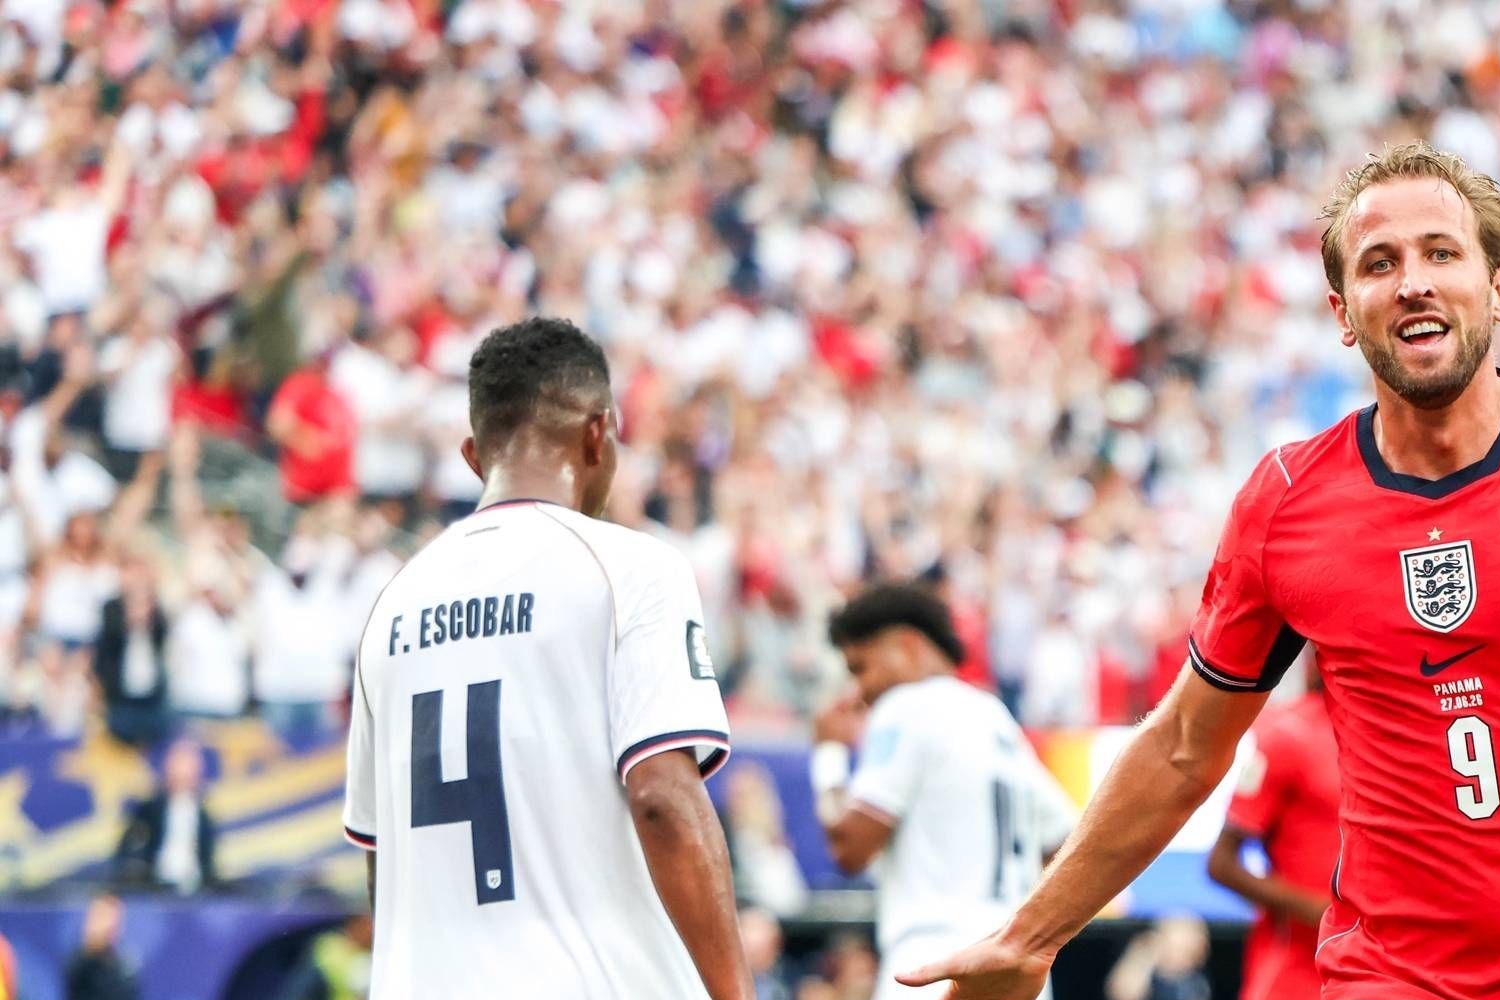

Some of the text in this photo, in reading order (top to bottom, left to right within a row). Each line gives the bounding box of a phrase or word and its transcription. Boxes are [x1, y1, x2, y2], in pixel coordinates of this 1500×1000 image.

[389, 592, 535, 656] F. ESCOBAR
[1433, 677, 1483, 696] PANAMA
[1440, 694, 1483, 711] 27.06.26
[411, 679, 515, 905] 4
